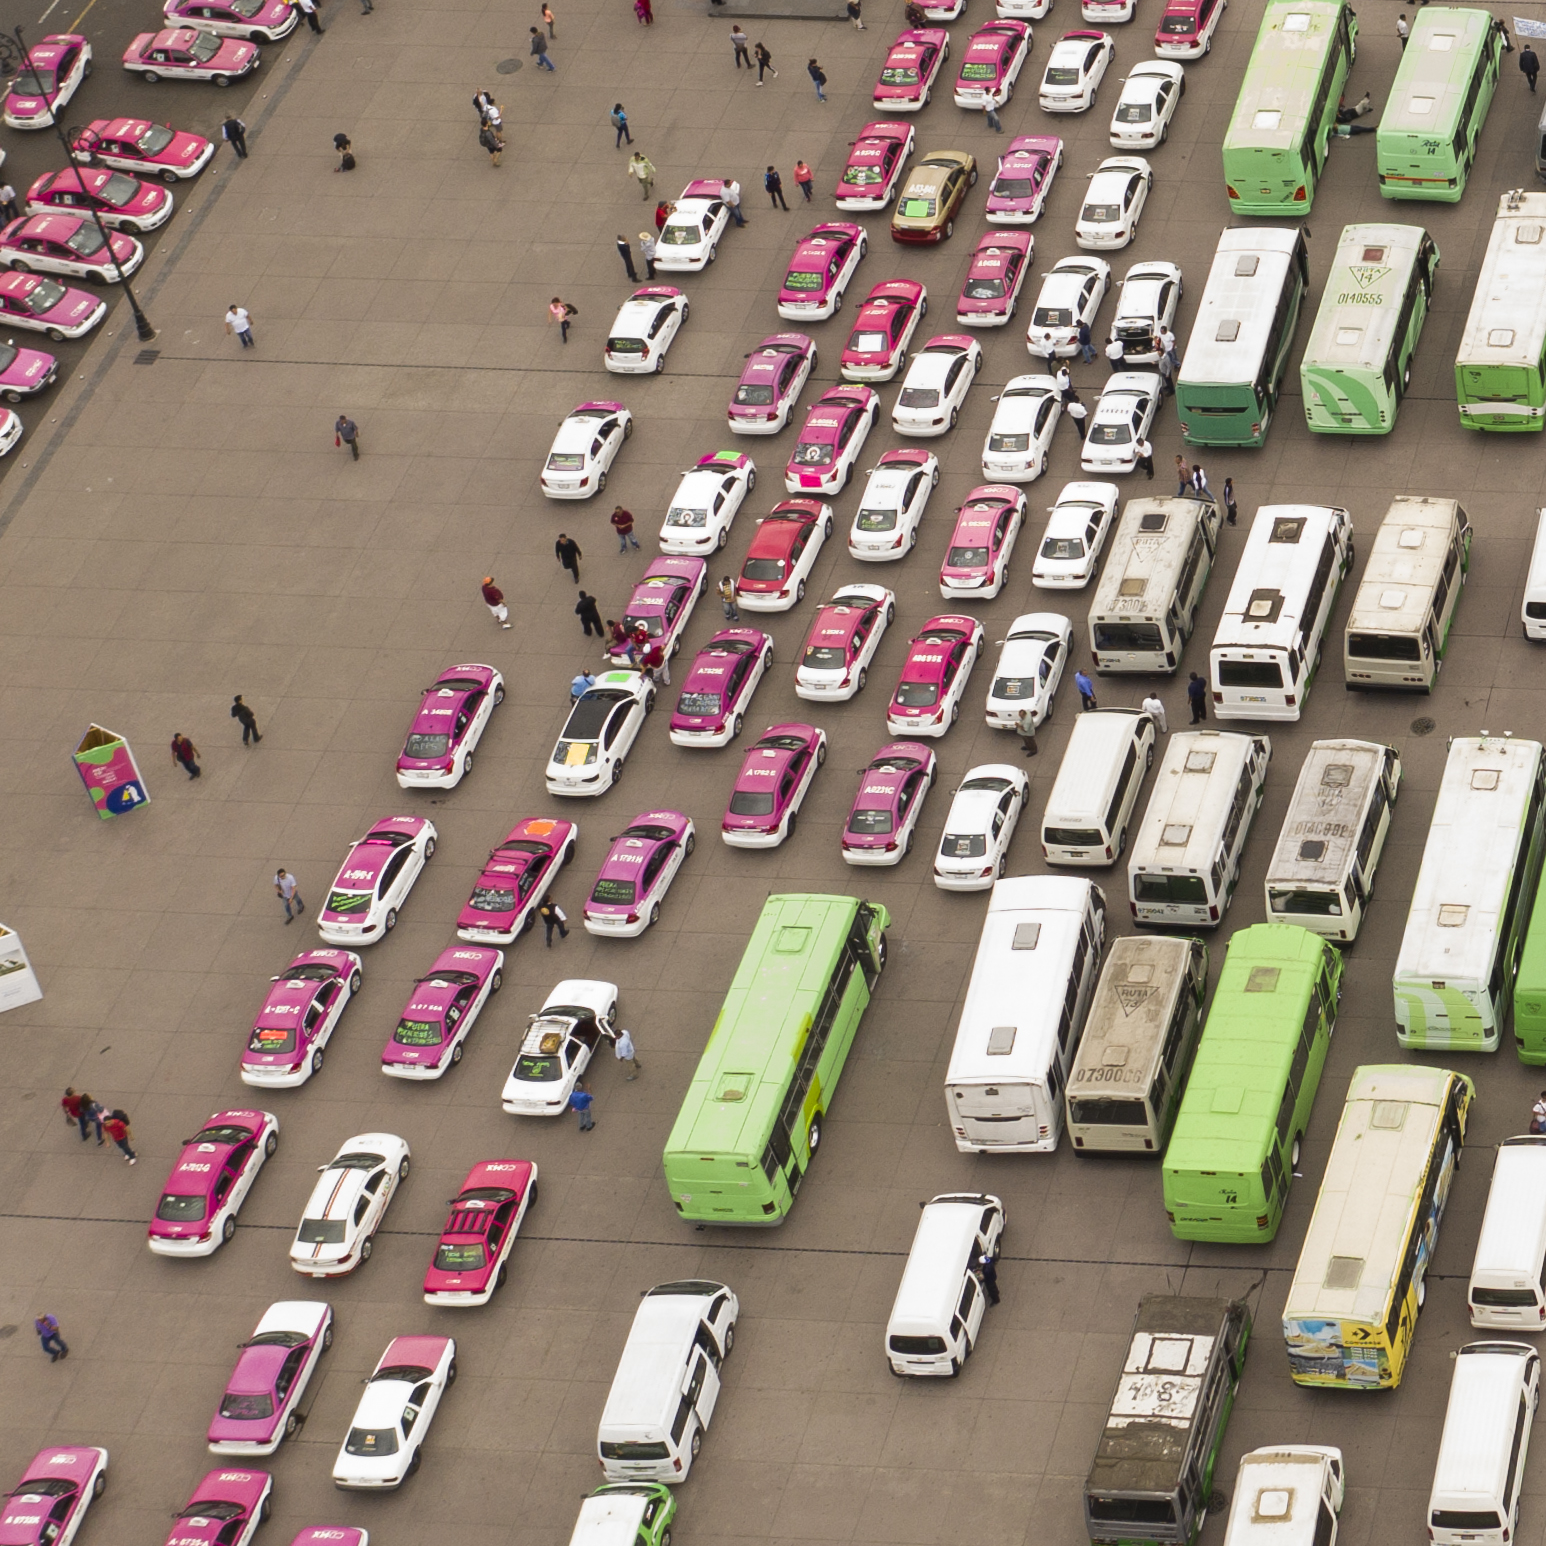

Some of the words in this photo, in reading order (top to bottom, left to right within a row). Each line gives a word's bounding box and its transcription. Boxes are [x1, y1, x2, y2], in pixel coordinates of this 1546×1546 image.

[1426, 146, 1436, 156] 14
[1360, 272, 1373, 282] 14
[1337, 293, 1383, 306] 0140555
[1122, 988, 1148, 998] RUTA
[1225, 1194, 1238, 1204] 14
[312, 1531, 344, 1539] CDMX
